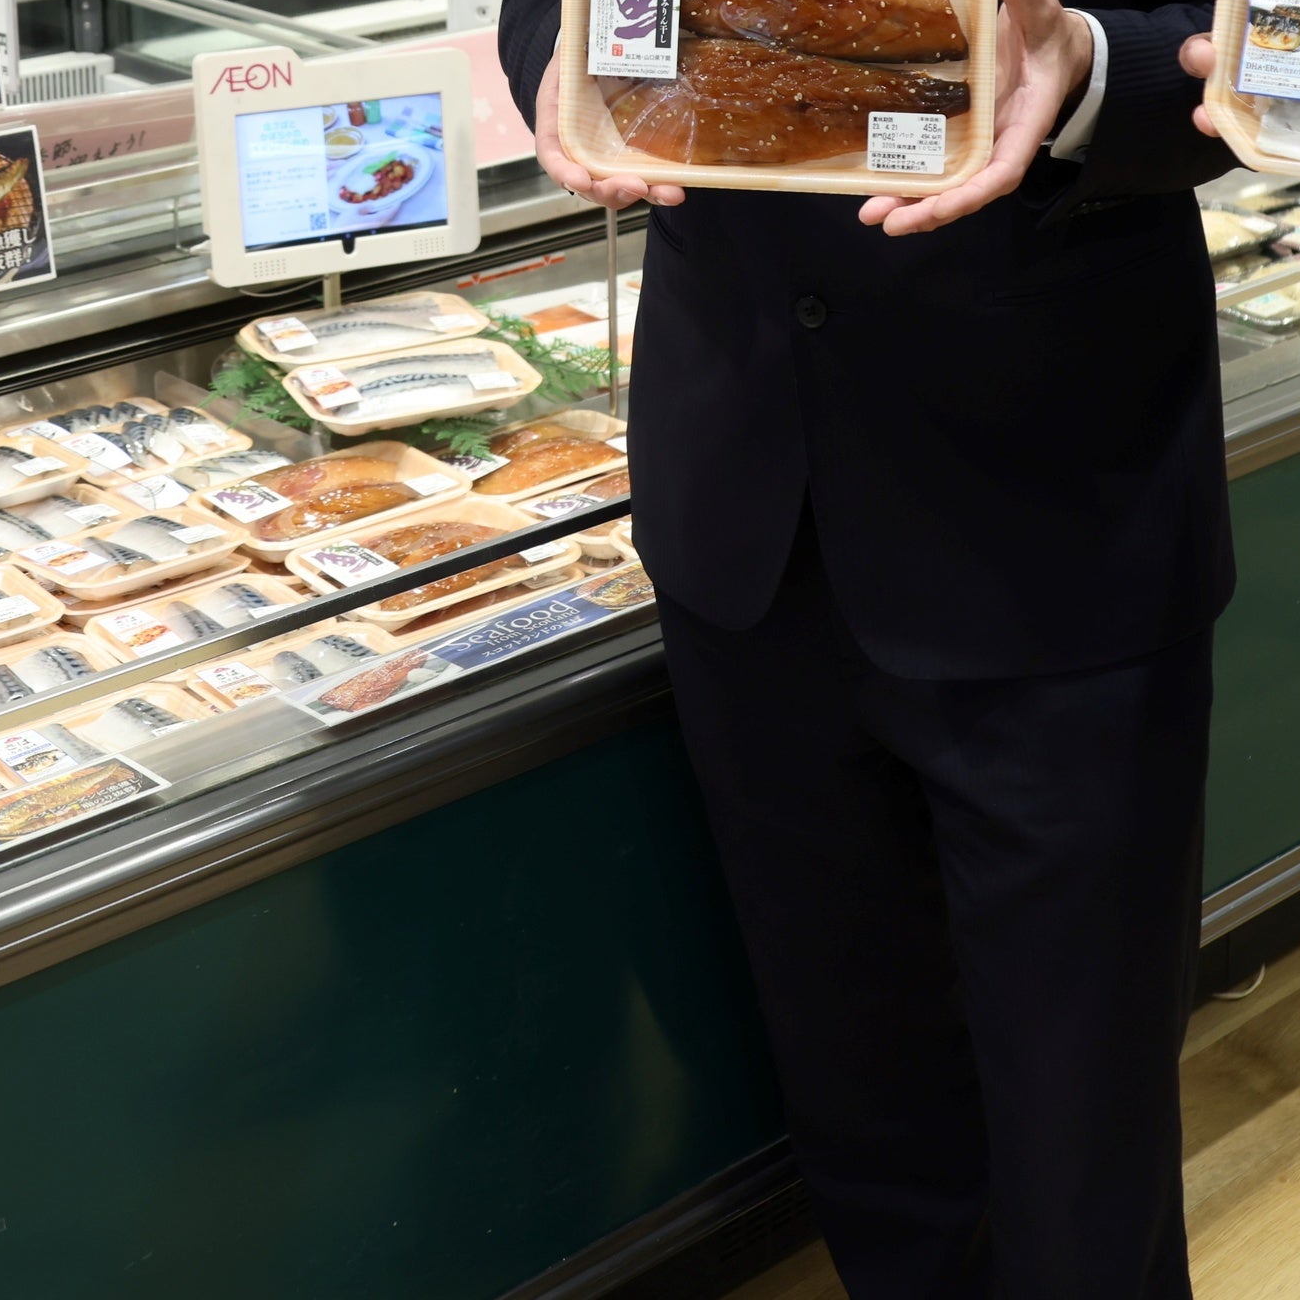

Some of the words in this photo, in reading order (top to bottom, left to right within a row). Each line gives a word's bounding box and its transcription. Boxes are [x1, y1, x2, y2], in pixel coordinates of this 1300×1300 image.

[451, 599, 574, 652] Seafood
[487, 629, 522, 647] from
[524, 607, 581, 633] Scotland
